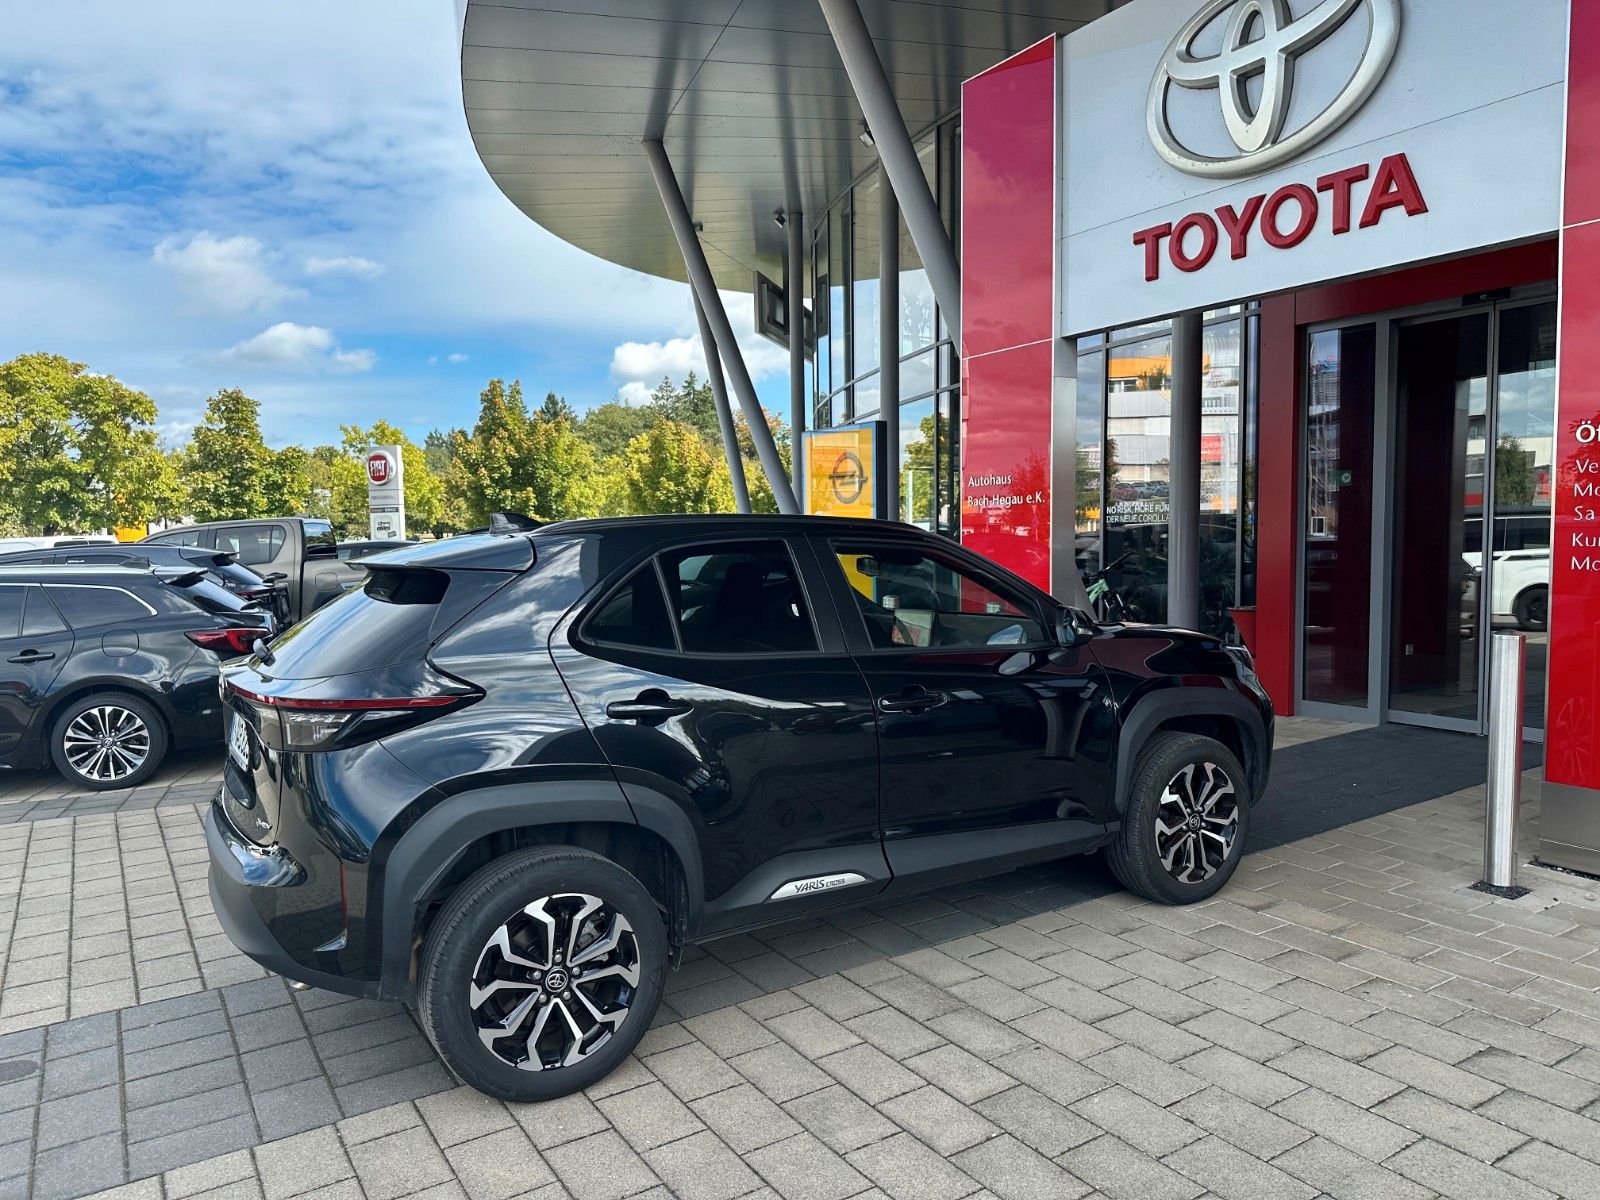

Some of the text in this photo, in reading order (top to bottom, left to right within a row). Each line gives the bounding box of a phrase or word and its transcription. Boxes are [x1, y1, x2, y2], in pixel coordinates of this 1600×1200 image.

[1133, 152, 1428, 281] TOYOTA
[370, 460, 385, 476] FIAT
[968, 474, 1012, 487] Autohaus
[967, 491, 1045, 508] Bach-Hegau e.K.
[1106, 506, 1116, 514] NO
[1135, 504, 1154, 513] MORE
[1574, 505, 1595, 521] Sa
[1106, 515, 1120, 523] DER
[1120, 515, 1137, 523] NEUE
[795, 879, 846, 893] YARIS CROSS
